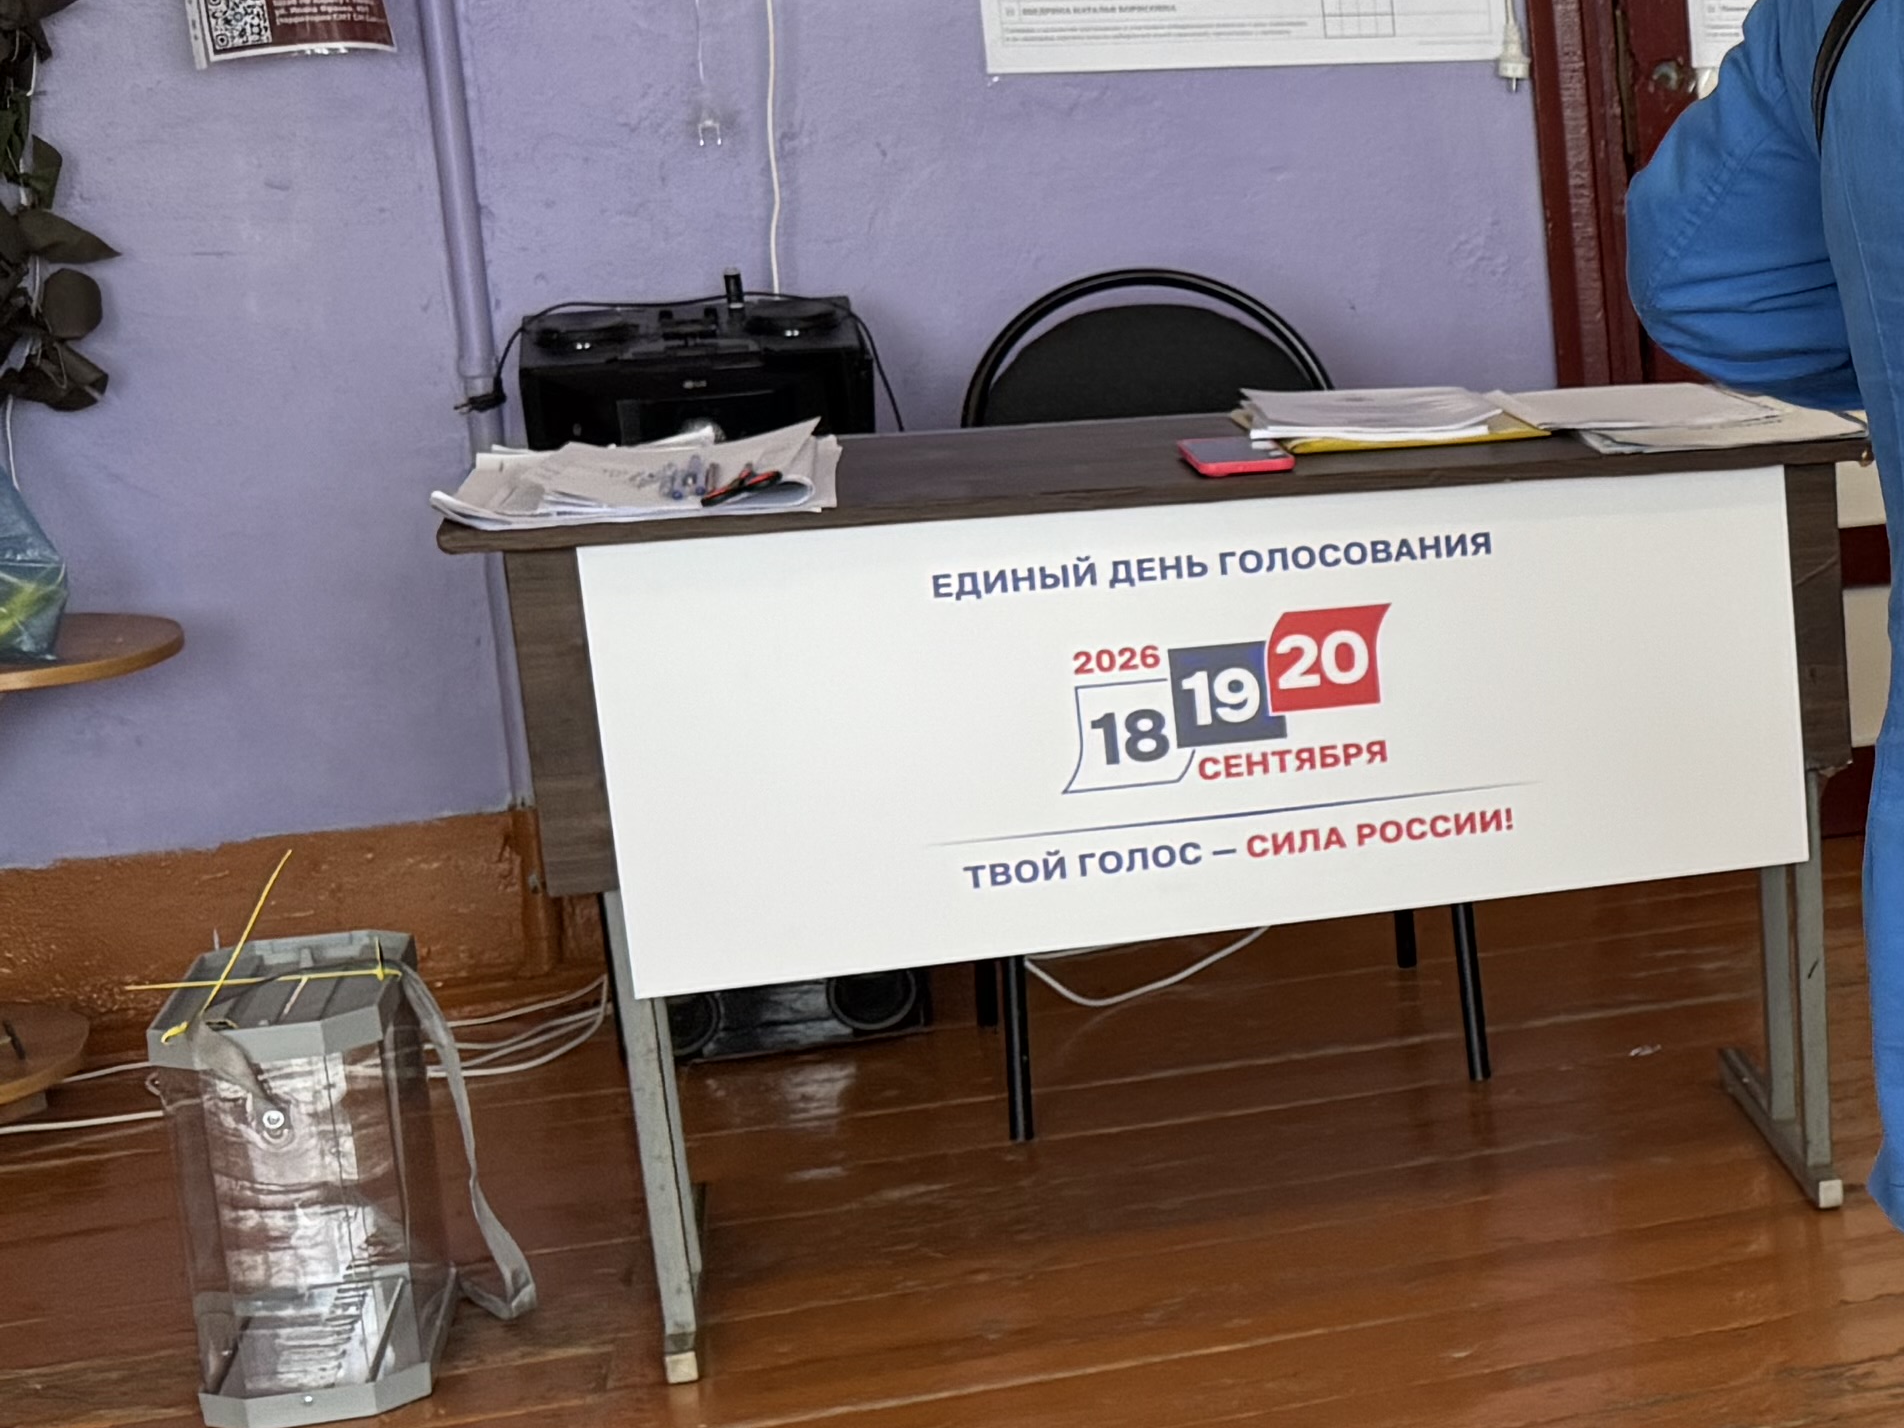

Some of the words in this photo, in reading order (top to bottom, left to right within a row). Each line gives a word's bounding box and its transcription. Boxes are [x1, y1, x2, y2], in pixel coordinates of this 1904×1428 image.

[931, 555, 1099, 602] ЕДИНЫЙ
[1108, 556, 1209, 589] ДЕНЬ
[1218, 530, 1493, 577] ГОЛОСОВАНИЯ
[1073, 644, 1161, 676] 2026
[1274, 629, 1370, 690] 20
[1181, 666, 1261, 727] 19
[1090, 707, 1170, 766] 18
[1197, 739, 1389, 782] СЕНТЯБРЯ
[962, 849, 1068, 891] ТВОЙ
[1077, 841, 1202, 879] ГОЛОС
[1245, 825, 1347, 860] СИЛА
[1356, 806, 1516, 848] РОССИИ!
